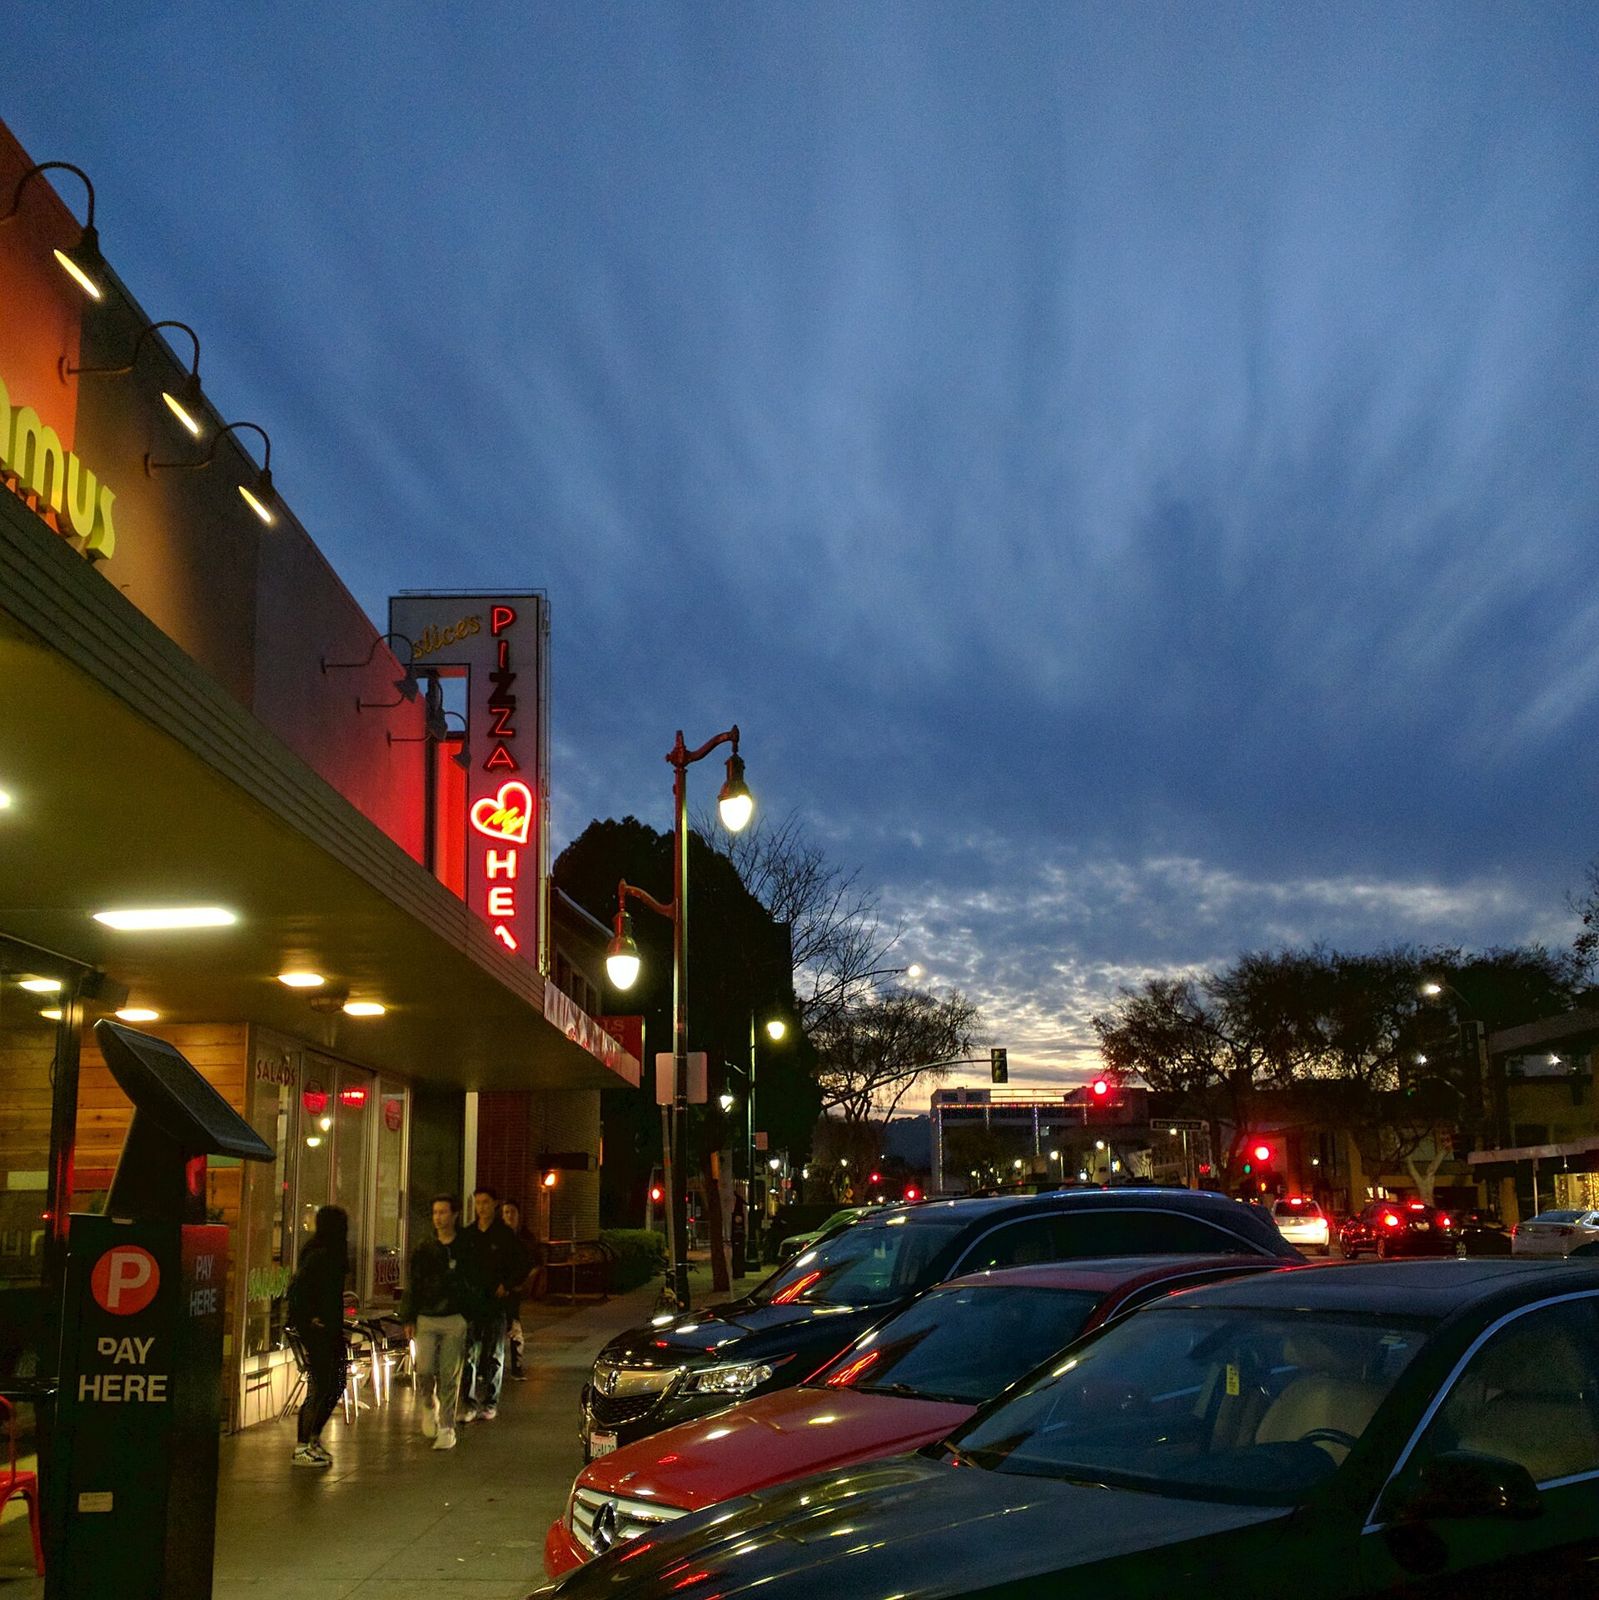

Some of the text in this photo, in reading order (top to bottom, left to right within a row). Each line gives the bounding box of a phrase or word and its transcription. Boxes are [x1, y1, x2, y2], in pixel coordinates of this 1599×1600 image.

[412, 615, 482, 660] slices
[483, 604, 519, 774] PIZZA
[483, 806, 525, 833] My
[257, 1058, 296, 1087] SALADS
[107, 1252, 151, 1307] P
[197, 1255, 214, 1280] PAY
[189, 1288, 217, 1317] HERE
[97, 1336, 155, 1364] PAY
[78, 1374, 168, 1402] HERE
